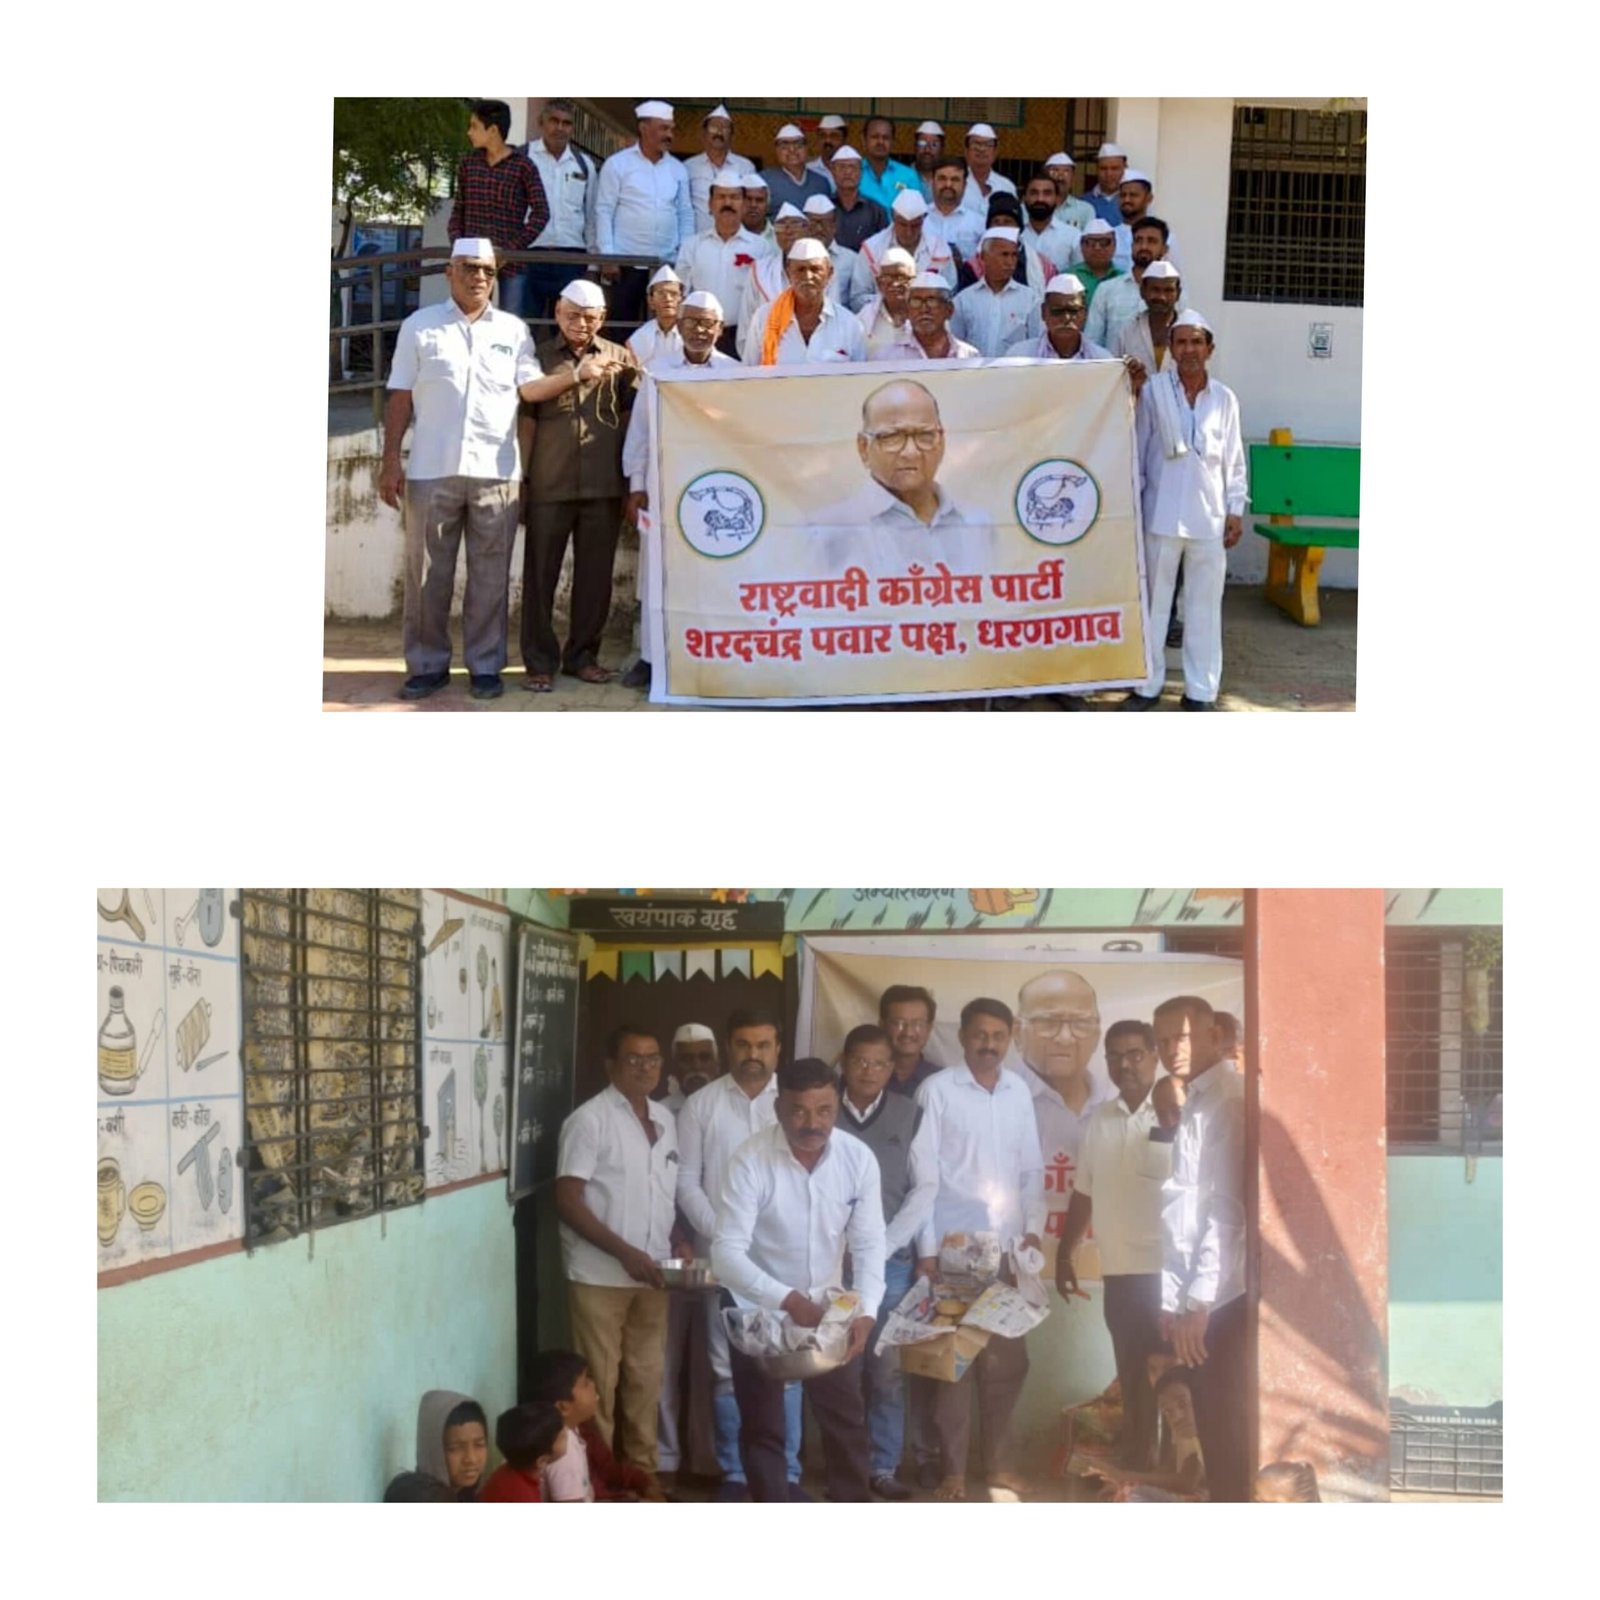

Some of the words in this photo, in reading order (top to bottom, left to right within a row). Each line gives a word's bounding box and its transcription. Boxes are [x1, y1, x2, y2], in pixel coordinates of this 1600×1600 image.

[739, 566, 868, 617] राष्ट्रवादी
[877, 562, 983, 608] काँग्रेस
[991, 559, 1064, 602] पार्टी
[684, 618, 801, 662] शरदचंद्र
[811, 624, 892, 657] पवार
[900, 622, 967, 655] पक्ष,
[977, 610, 1122, 650] धरणगाव
[609, 903, 697, 928] स्वयंपाक
[700, 908, 738, 931] गृह
